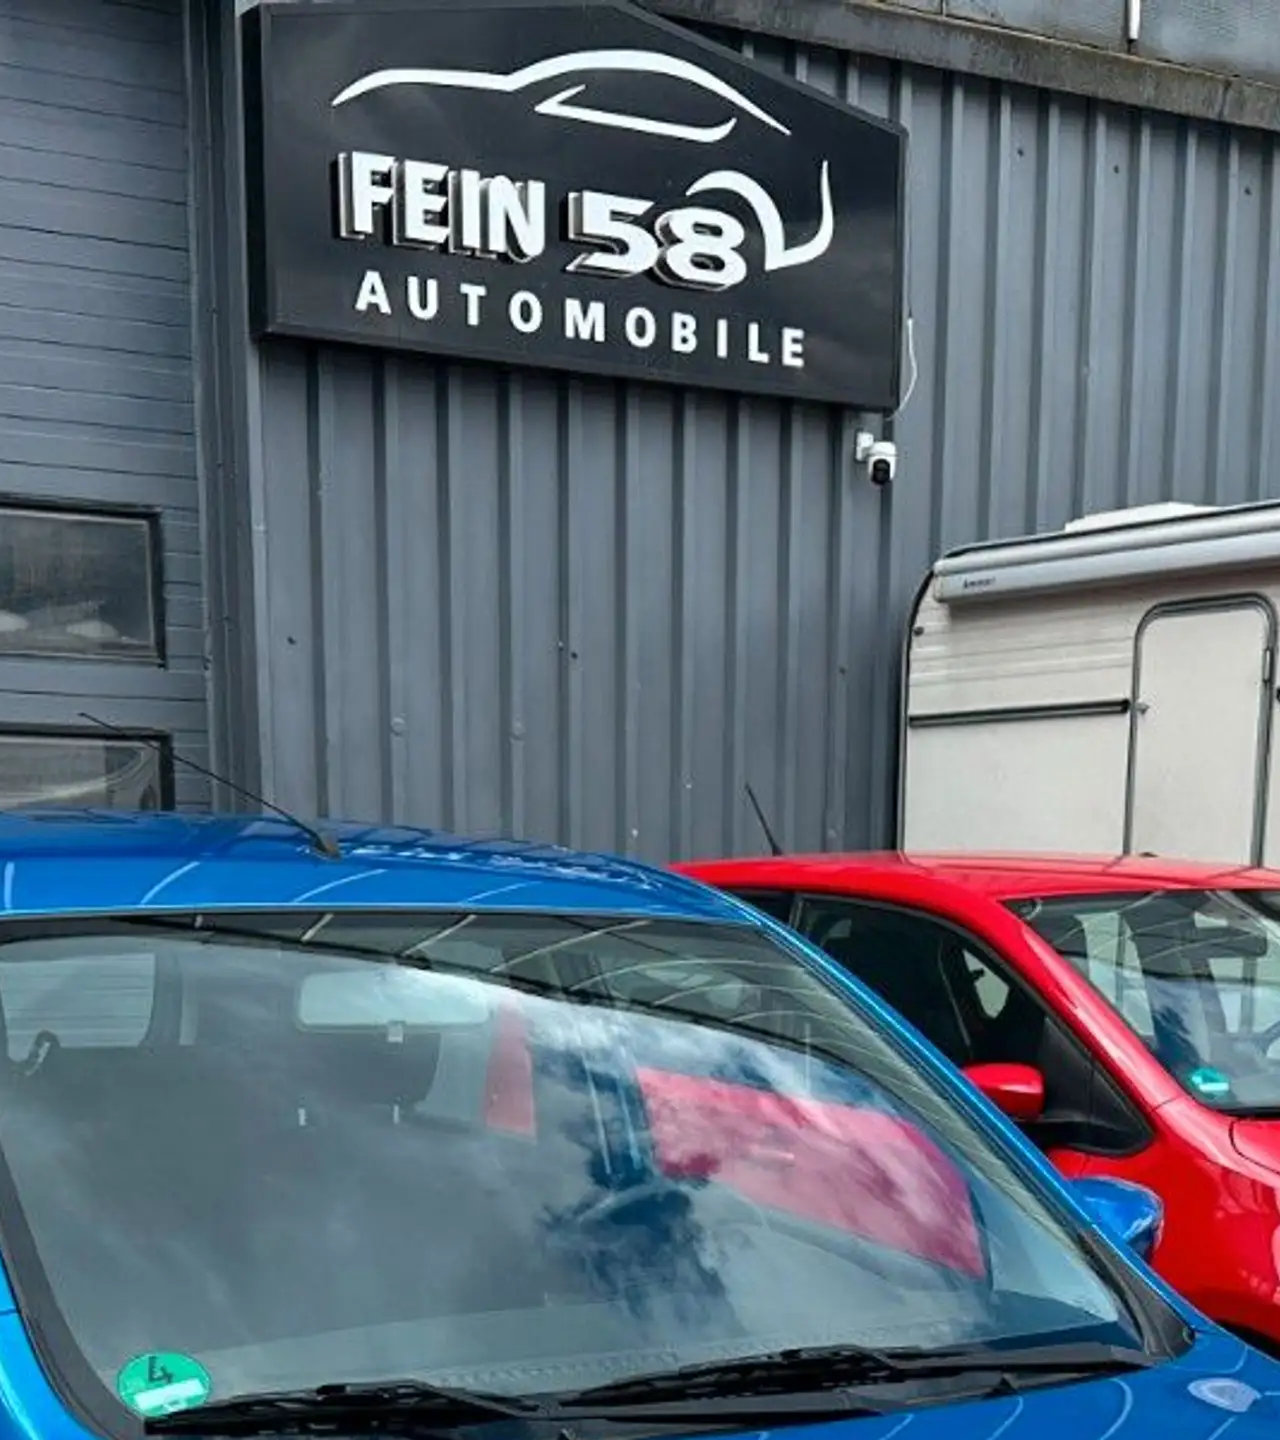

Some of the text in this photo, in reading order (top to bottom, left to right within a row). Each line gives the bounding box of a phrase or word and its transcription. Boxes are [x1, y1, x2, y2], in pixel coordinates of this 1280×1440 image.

[333, 150, 750, 291] FEIN 58
[355, 269, 807, 369] AUTOMOBILE
[147, 1355, 175, 1385] 4
